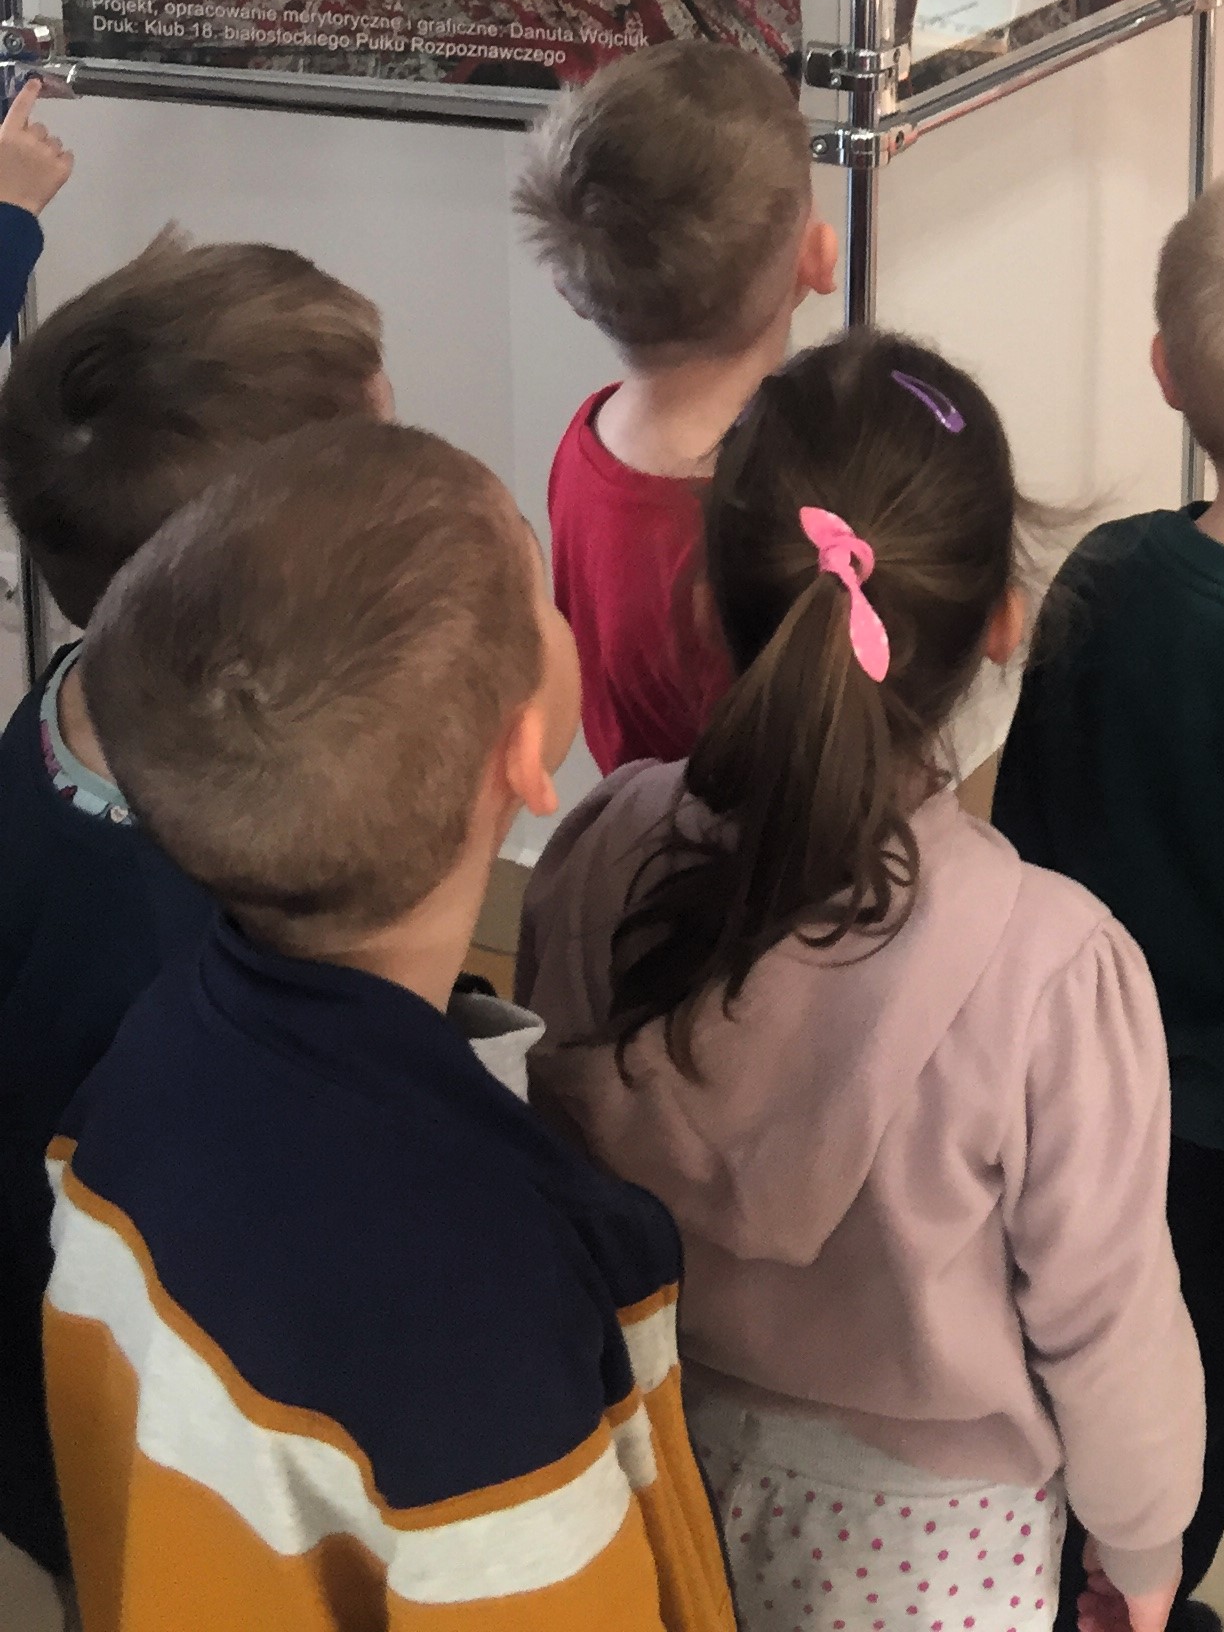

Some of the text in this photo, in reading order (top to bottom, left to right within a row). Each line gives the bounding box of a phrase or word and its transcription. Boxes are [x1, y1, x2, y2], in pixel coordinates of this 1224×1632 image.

[93, 15, 138, 35] Druk:
[144, 17, 185, 37] Klub
[223, 25, 350, 51] białostockiego
[356, 32, 405, 52] Pułku
[410, 39, 566, 67] Rozpoznawczego
[164, 2, 277, 21] opracowanie
[283, 9, 402, 31] merytoryczne
[510, 22, 573, 42] Danuta
